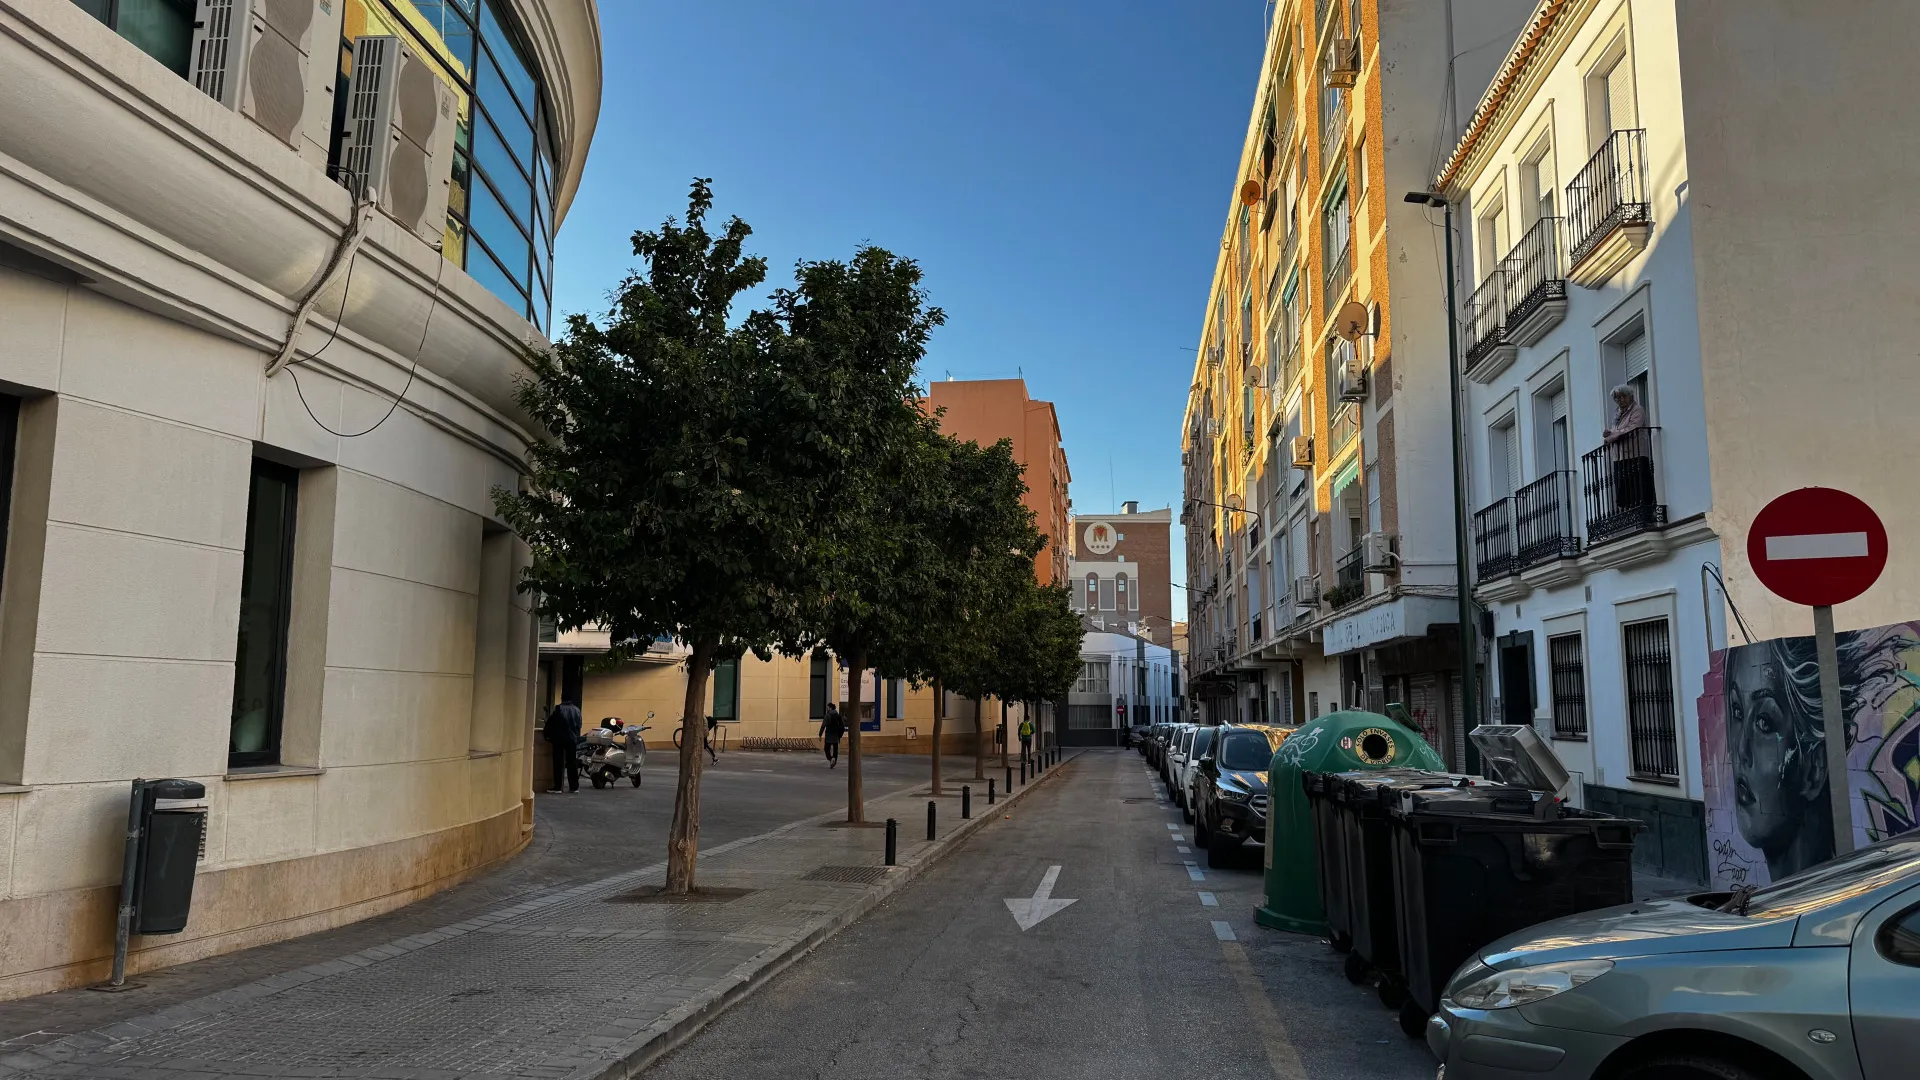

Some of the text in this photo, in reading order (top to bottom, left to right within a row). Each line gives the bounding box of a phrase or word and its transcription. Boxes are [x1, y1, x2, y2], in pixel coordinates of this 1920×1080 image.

[1356, 728, 1394, 749] SOLO ENVASES
[1360, 754, 1392, 765] DE VIDRIO
